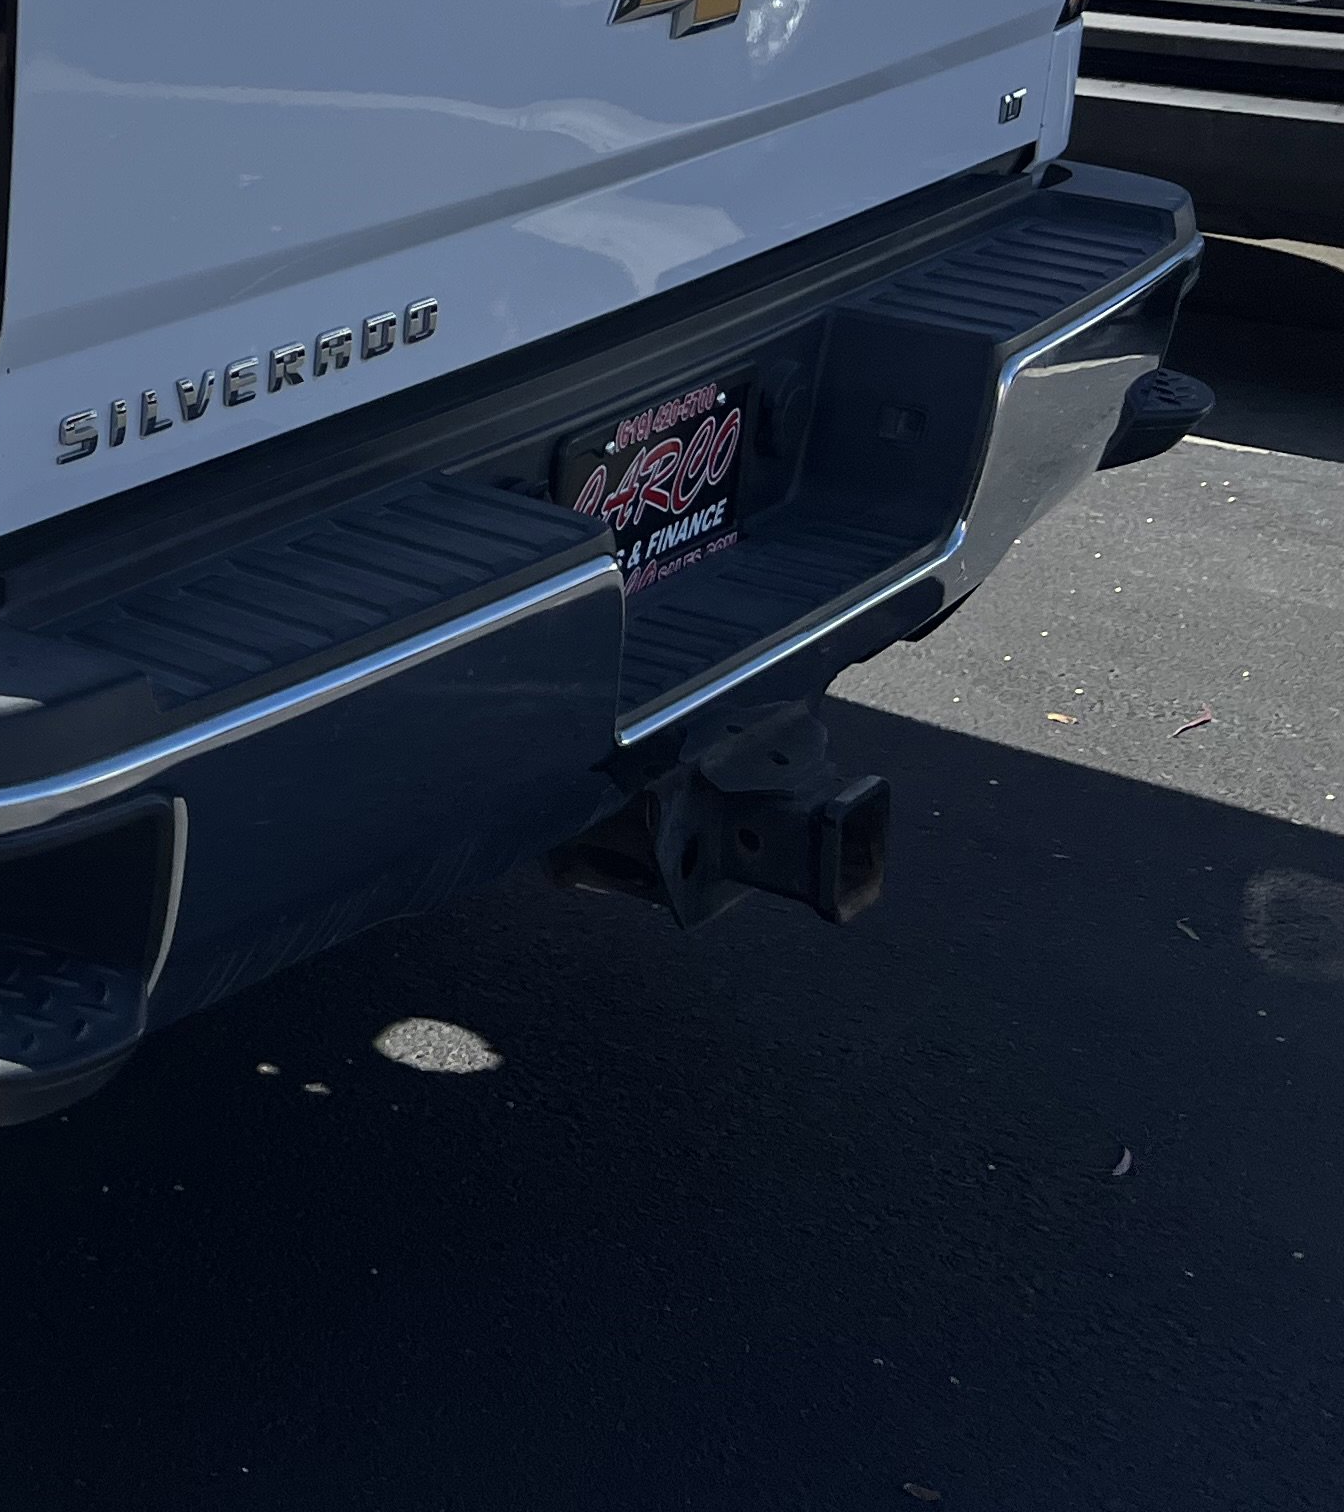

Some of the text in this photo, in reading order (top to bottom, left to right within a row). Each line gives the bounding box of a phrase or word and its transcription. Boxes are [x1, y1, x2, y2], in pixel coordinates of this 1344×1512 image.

[998, 86, 1028, 125] LT
[56, 296, 439, 465] SILVERADO
[614, 408, 654, 453] (619)
[645, 497, 728, 559] FINANCE
